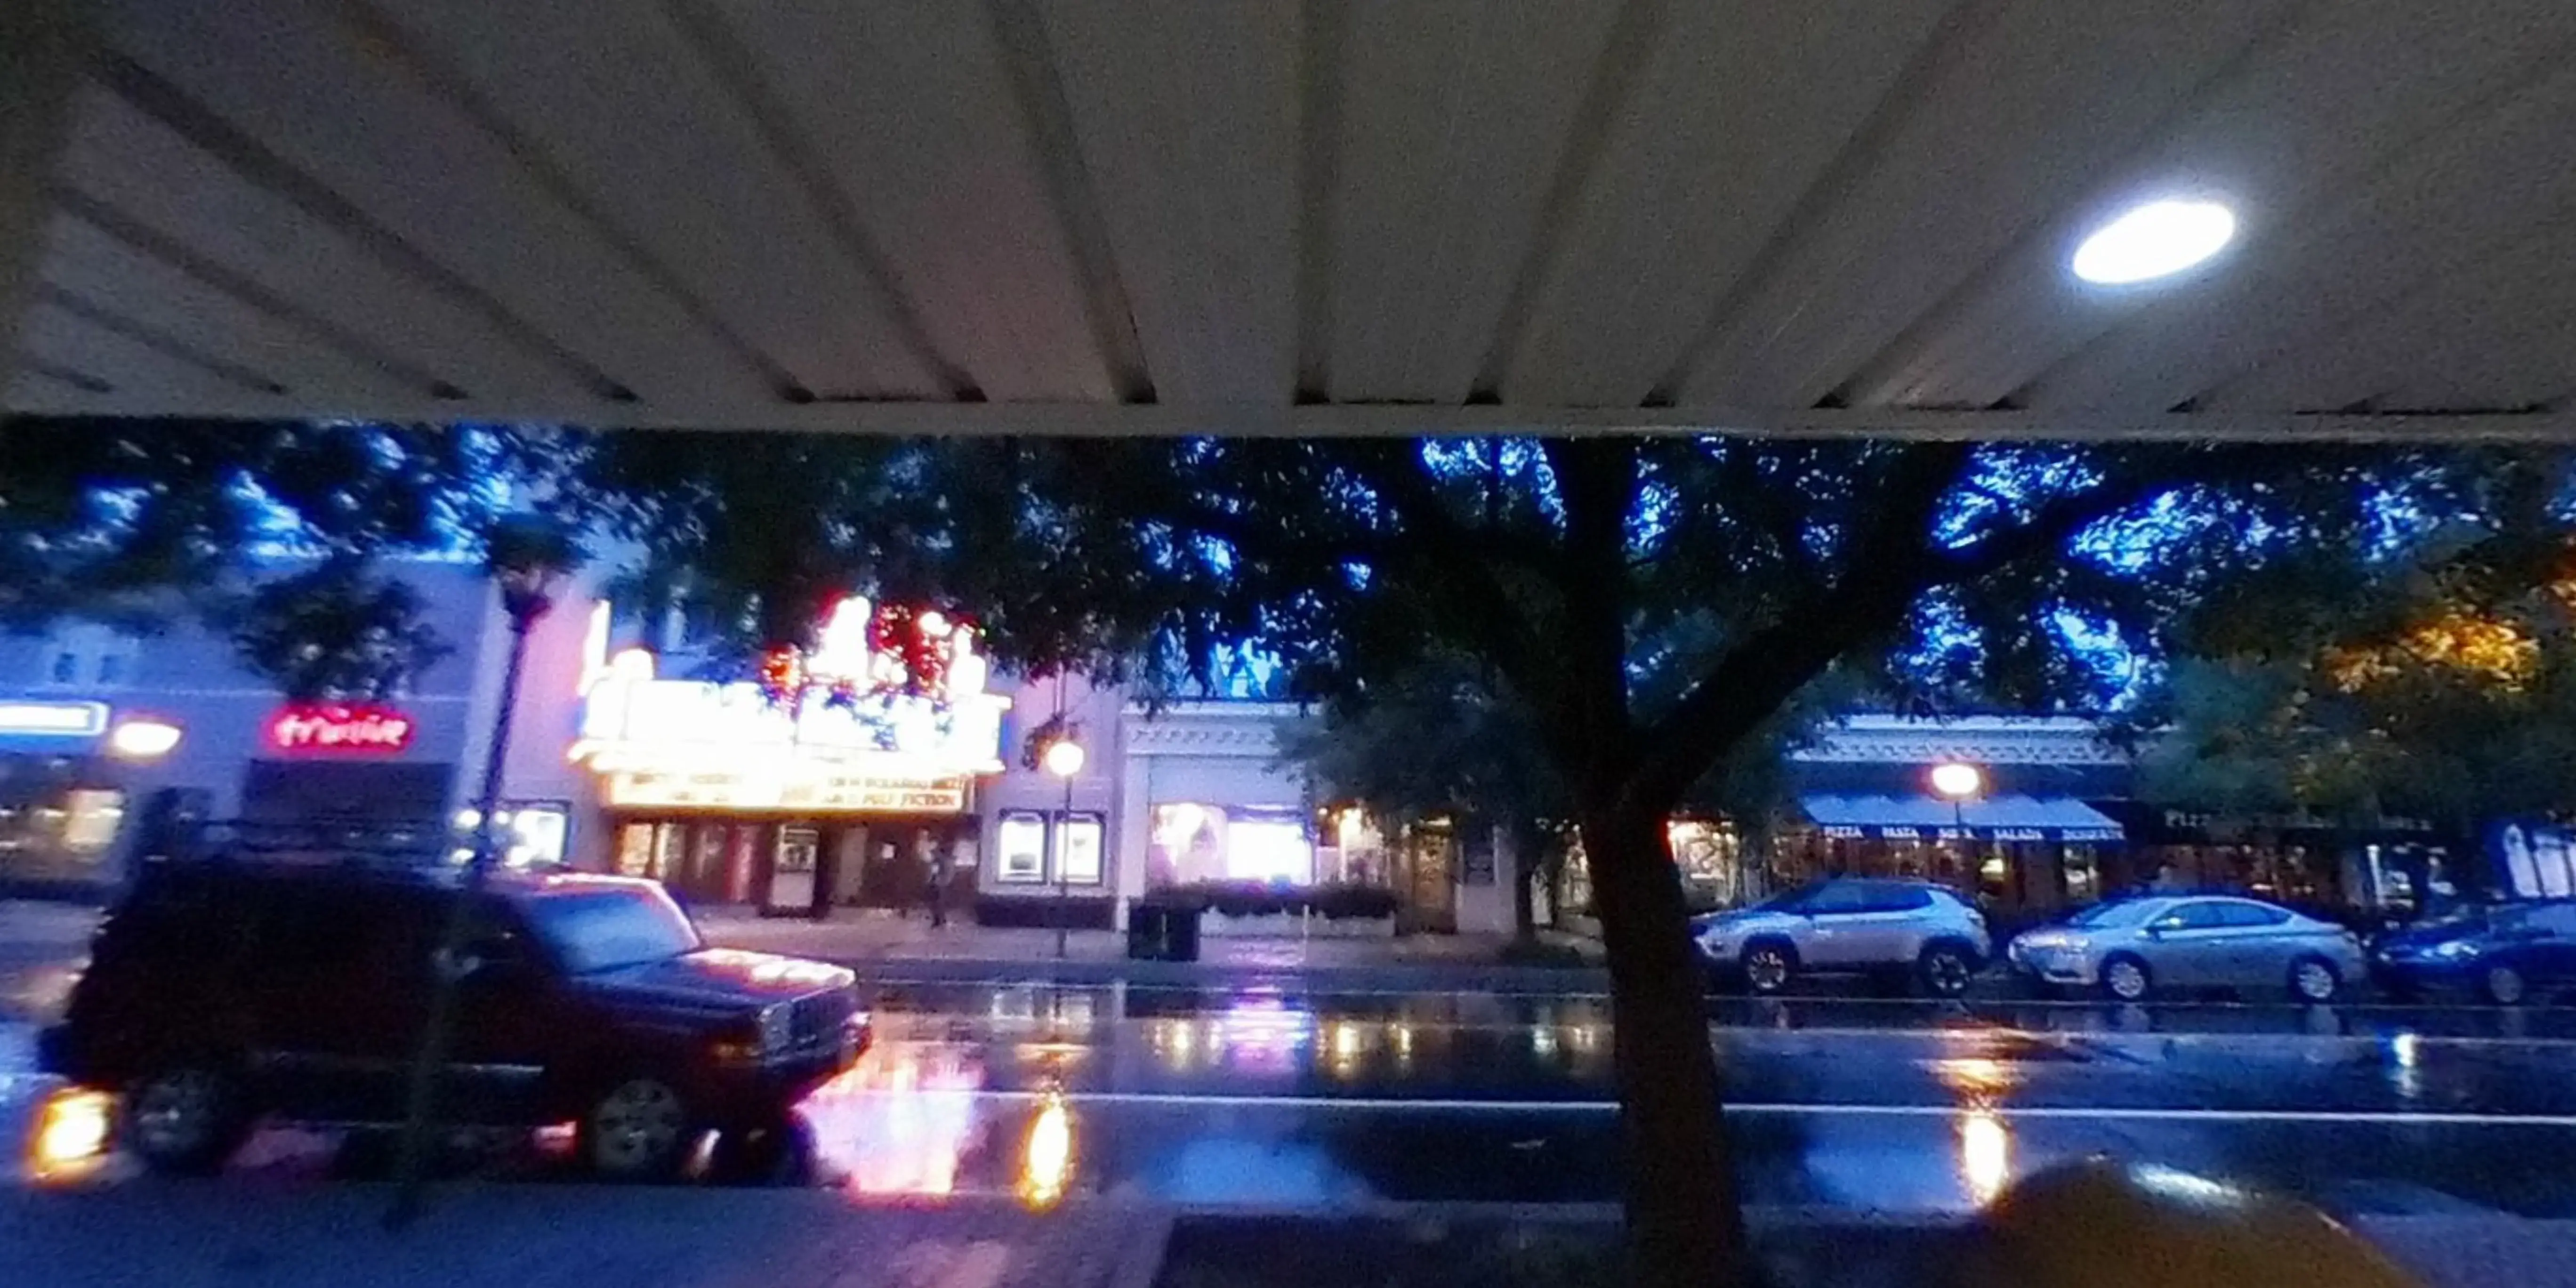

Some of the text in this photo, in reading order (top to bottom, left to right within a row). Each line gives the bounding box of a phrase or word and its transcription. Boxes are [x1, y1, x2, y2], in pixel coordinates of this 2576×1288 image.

[900, 792, 955, 807] FICTION
[1824, 826, 1863, 838] PIZZA
[1882, 827, 1920, 839] PASTA
[1993, 828, 2043, 840] SALADS
